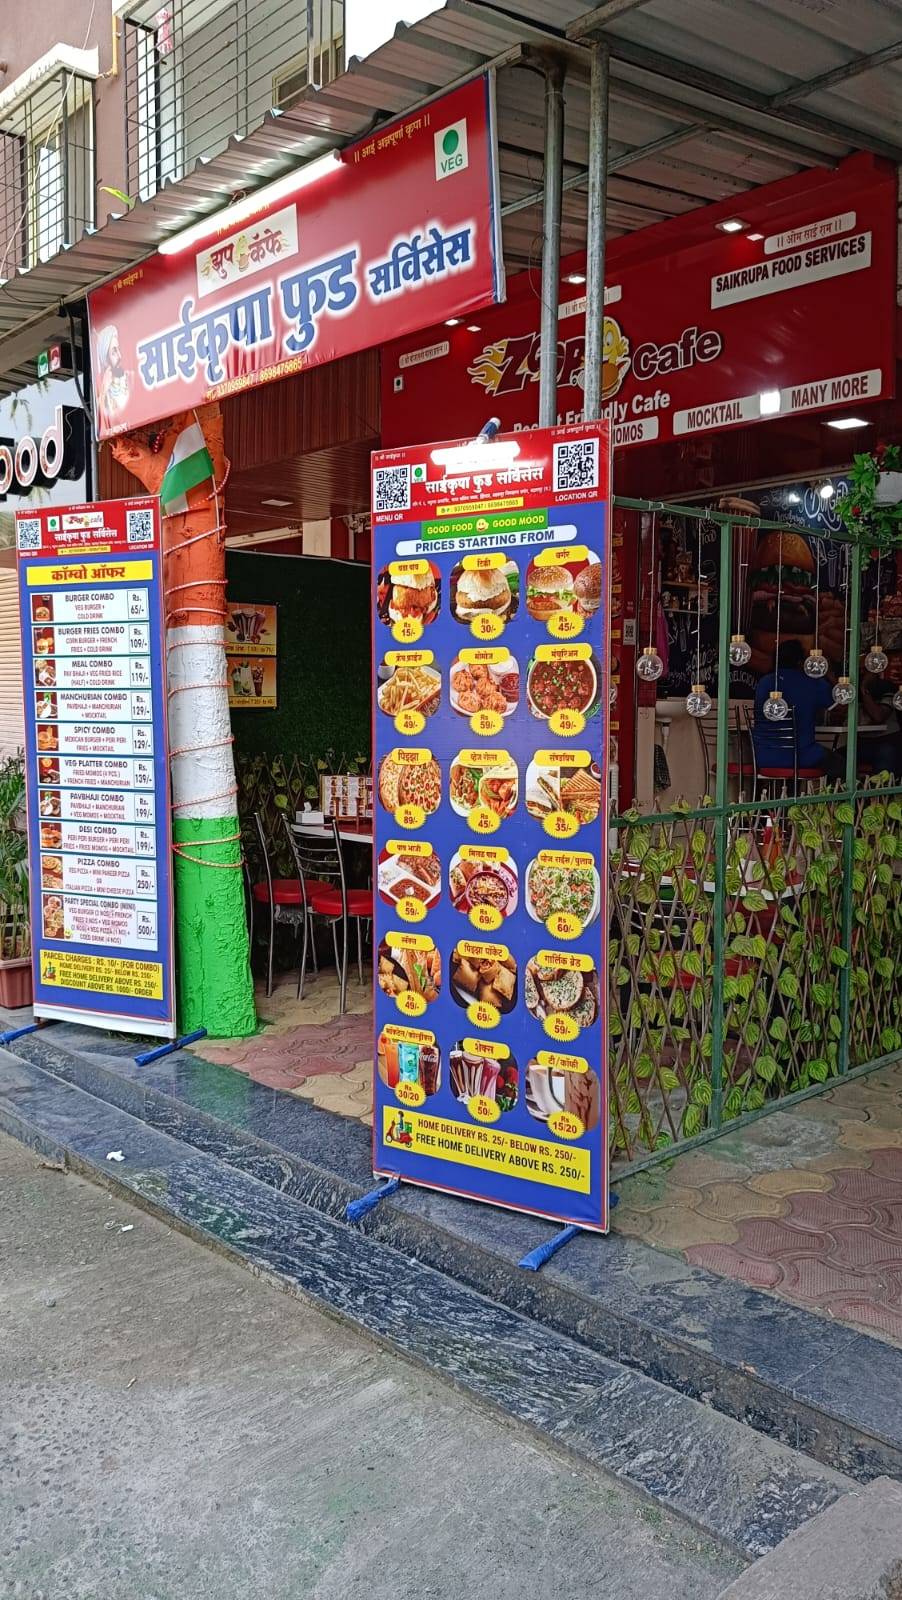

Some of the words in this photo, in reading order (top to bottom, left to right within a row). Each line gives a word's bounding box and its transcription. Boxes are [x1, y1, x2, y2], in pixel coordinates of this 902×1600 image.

[405, 117, 422, 141] कृपा
[441, 154, 463, 174] VEG
[803, 222, 819, 240] साई
[820, 222, 832, 236] राम
[211, 243, 234, 279] झुप
[715, 264, 770, 293] SAIKRUPA
[772, 252, 801, 278] FOOD
[804, 239, 867, 269] SERVICES
[138, 287, 272, 384] साईकृपा
[281, 250, 357, 351] फुड
[368, 227, 472, 296] सर्विसेस
[791, 384, 828, 409] MANY
[831, 375, 869, 401] MORE
[632, 390, 670, 415] Cafe
[687, 402, 743, 429] MOCKTAIL
[425, 472, 471, 496] साईकृपा
[473, 473, 493, 493] फुड
[555, 493, 587, 503] LOCATION
[588, 491, 598, 500] QR
[376, 514, 393, 523] MENU
[394, 512, 403, 521] QR
[427, 524, 450, 535] GOOD
[452, 522, 473, 533] FOOD
[493, 518, 517, 529] GOOD
[519, 514, 545, 526] MOOD
[415, 540, 456, 553] PRICES
[459, 535, 518, 549] STARTING
[520, 530, 555, 543] FROM
[51, 565, 87, 581] कॉम्बो
[90, 564, 125, 579] ऑफर
[65, 594, 90, 602] BURGER
[91, 593, 115, 601] COMBO
[131, 605, 144, 615] 65/-
[58, 627, 81, 635] BURGER
[101, 626, 125, 634] COMBO
[401, 627, 415, 636] 15/-
[481, 624, 496, 634] 30/-
[558, 623, 575, 632] 45/-
[131, 639, 147, 648] 109/-
[132, 673, 148, 683] 119/-
[133, 705, 150, 716] 129/-
[403, 720, 418, 729] 49/-
[480, 720, 496, 730] 59/-
[560, 720, 576, 730] 49/-
[74, 726, 90, 734] SPICY
[92, 726, 115, 734] COMBO
[134, 740, 150, 749] 129/-
[104, 761, 128, 769] COMBO
[135, 774, 152, 784] 139/-
[101, 794, 124, 802] COMBO
[136, 808, 152, 818] 199/-
[403, 816, 418, 825] 89/-
[478, 820, 493, 829] 45/-
[79, 825, 92, 833] DESI
[94, 826, 117, 834] COMBO
[555, 823, 571, 832] 35/-
[137, 841, 153, 851] 199/-
[78, 858, 95, 866] PIZZA
[97, 859, 120, 868] COMBO
[137, 879, 154, 889] 250/-
[65, 897, 79, 905] PARTY
[80, 898, 99, 907] SPECIAL
[101, 900, 119, 909] COMBO
[405, 907, 419, 917] 59/-
[479, 914, 495, 924] 69/-
[138, 925, 155, 935] 500/-
[557, 923, 574, 932] 60/-
[43, 952, 64, 961] PARCEL
[65, 954, 92, 963] CHARGES
[73, 971, 88, 979] HOME
[90, 973, 113, 983] DELIVERY
[115, 976, 132, 985] ABOVE
[60, 978, 86, 988] DISCOUNT
[88, 981, 105, 990] ABOVE
[134, 987, 153, 996] ORDER
[405, 1001, 420, 1010] 49/-
[477, 1012, 492, 1022] 69/-
[554, 1025, 571, 1035] 59/-
[475, 1042, 494, 1054] शेक्स
[548, 1055, 556, 1065] टी
[561, 1056, 578, 1070] कॉफी
[398, 1090, 419, 1102] 30/20
[478, 1106, 493, 1117] 50/-
[552, 1121, 577, 1135] 15/20
[418, 1118, 439, 1133] HOME
[441, 1124, 476, 1141] DELIVERY
[478, 1132, 490, 1142] RS.
[492, 1136, 508, 1147] 25/-
[510, 1140, 537, 1154] BELOW
[539, 1146, 552, 1157] RS.
[555, 1149, 576, 1162] 250/-
[416, 1132, 436, 1146] FREE
[438, 1137, 463, 1153] HOME
[465, 1144, 506, 1163] DELIVERY
[508, 1154, 540, 1171] ABOVE
[542, 1162, 557, 1174] RS.
[560, 1166, 585, 1180] 250/-
